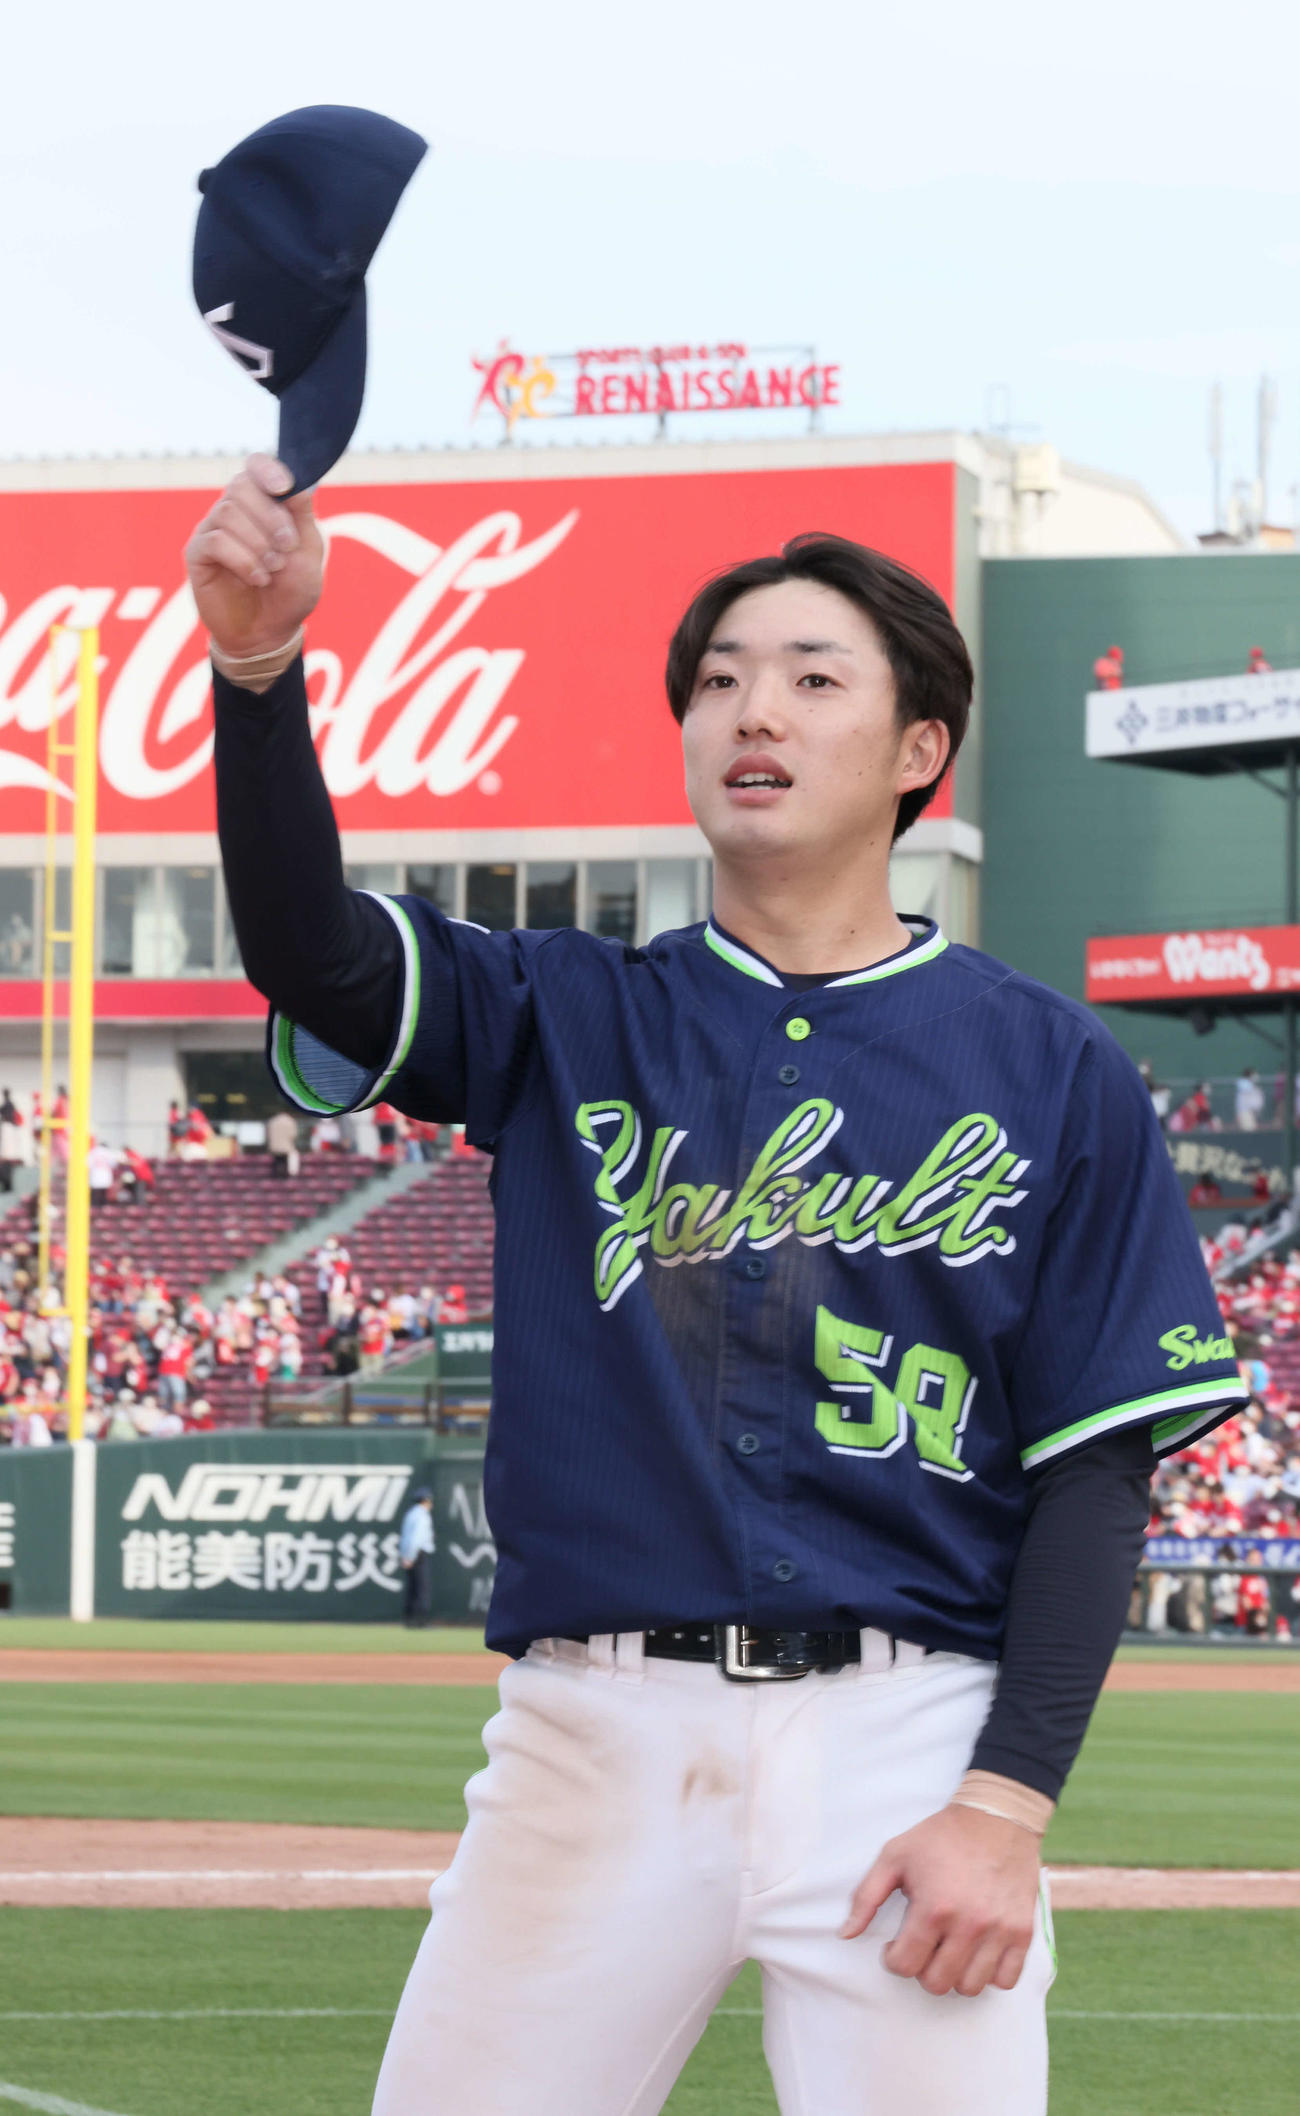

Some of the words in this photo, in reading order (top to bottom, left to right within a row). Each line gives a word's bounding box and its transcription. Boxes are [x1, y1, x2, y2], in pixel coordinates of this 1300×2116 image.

[575, 364, 840, 415] RENAISSANCE
[576, 1098, 1032, 1312] Yakult
[814, 1304, 979, 1484] 58
[121, 1463, 413, 1522] NOHMI
[120, 1529, 404, 1593] 能美防災
